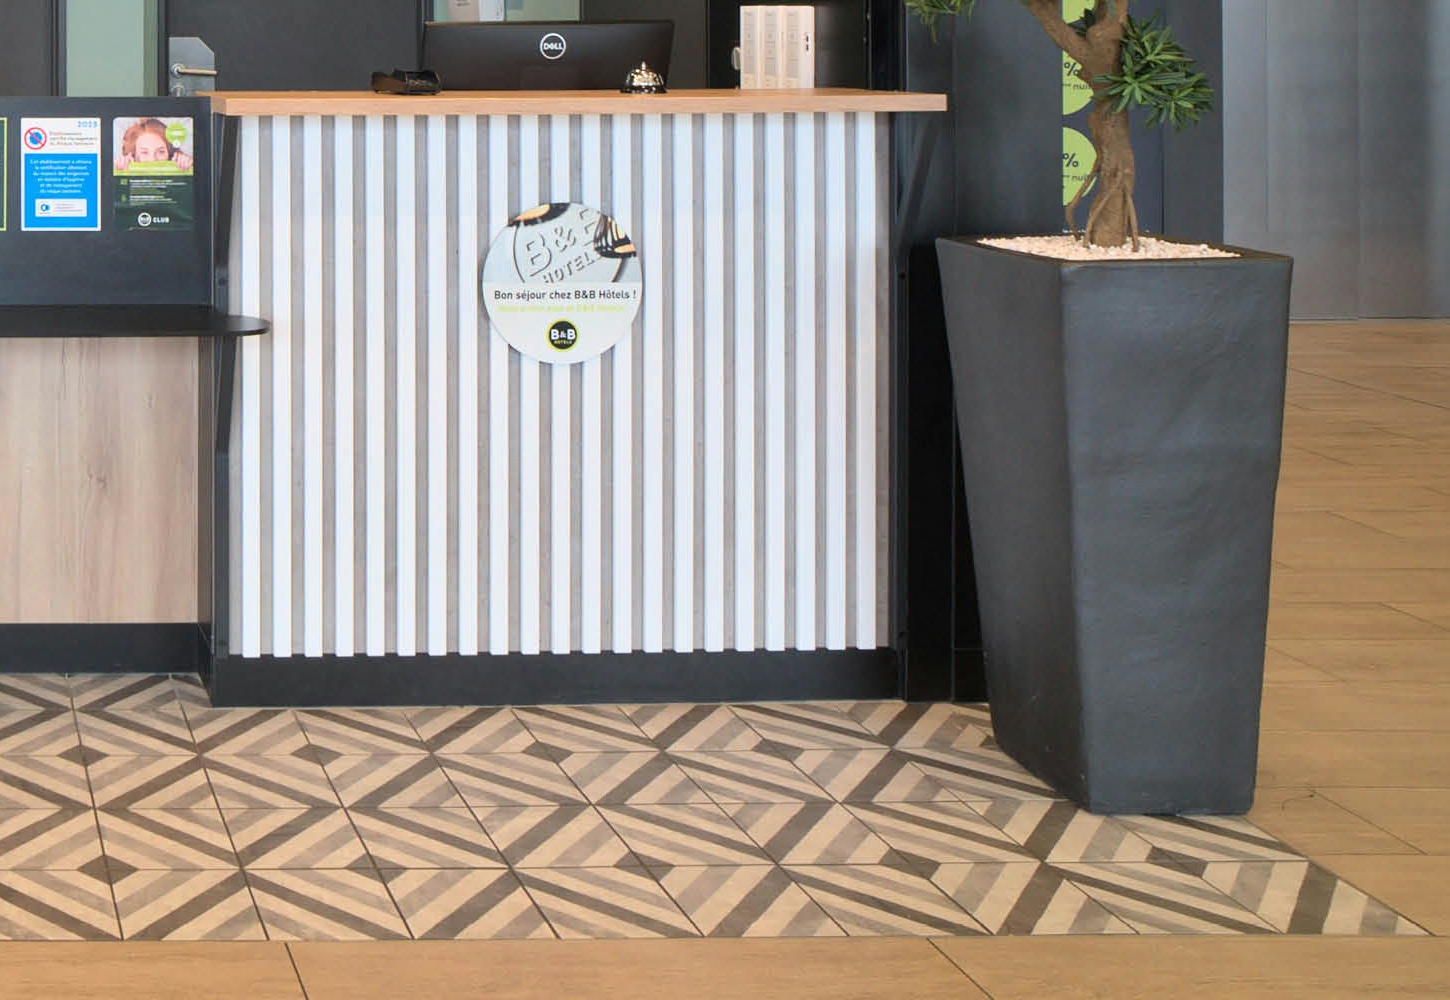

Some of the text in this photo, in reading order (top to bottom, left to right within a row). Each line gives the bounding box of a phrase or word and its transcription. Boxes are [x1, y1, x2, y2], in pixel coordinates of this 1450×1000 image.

[543, 42, 564, 50] DELL
[494, 290, 513, 300] Bon
[516, 290, 546, 301] séjour
[549, 290, 571, 300] chez
[574, 290, 596, 300] B&B
[599, 290, 630, 300] Hôtels
[550, 328, 576, 340] B&B
